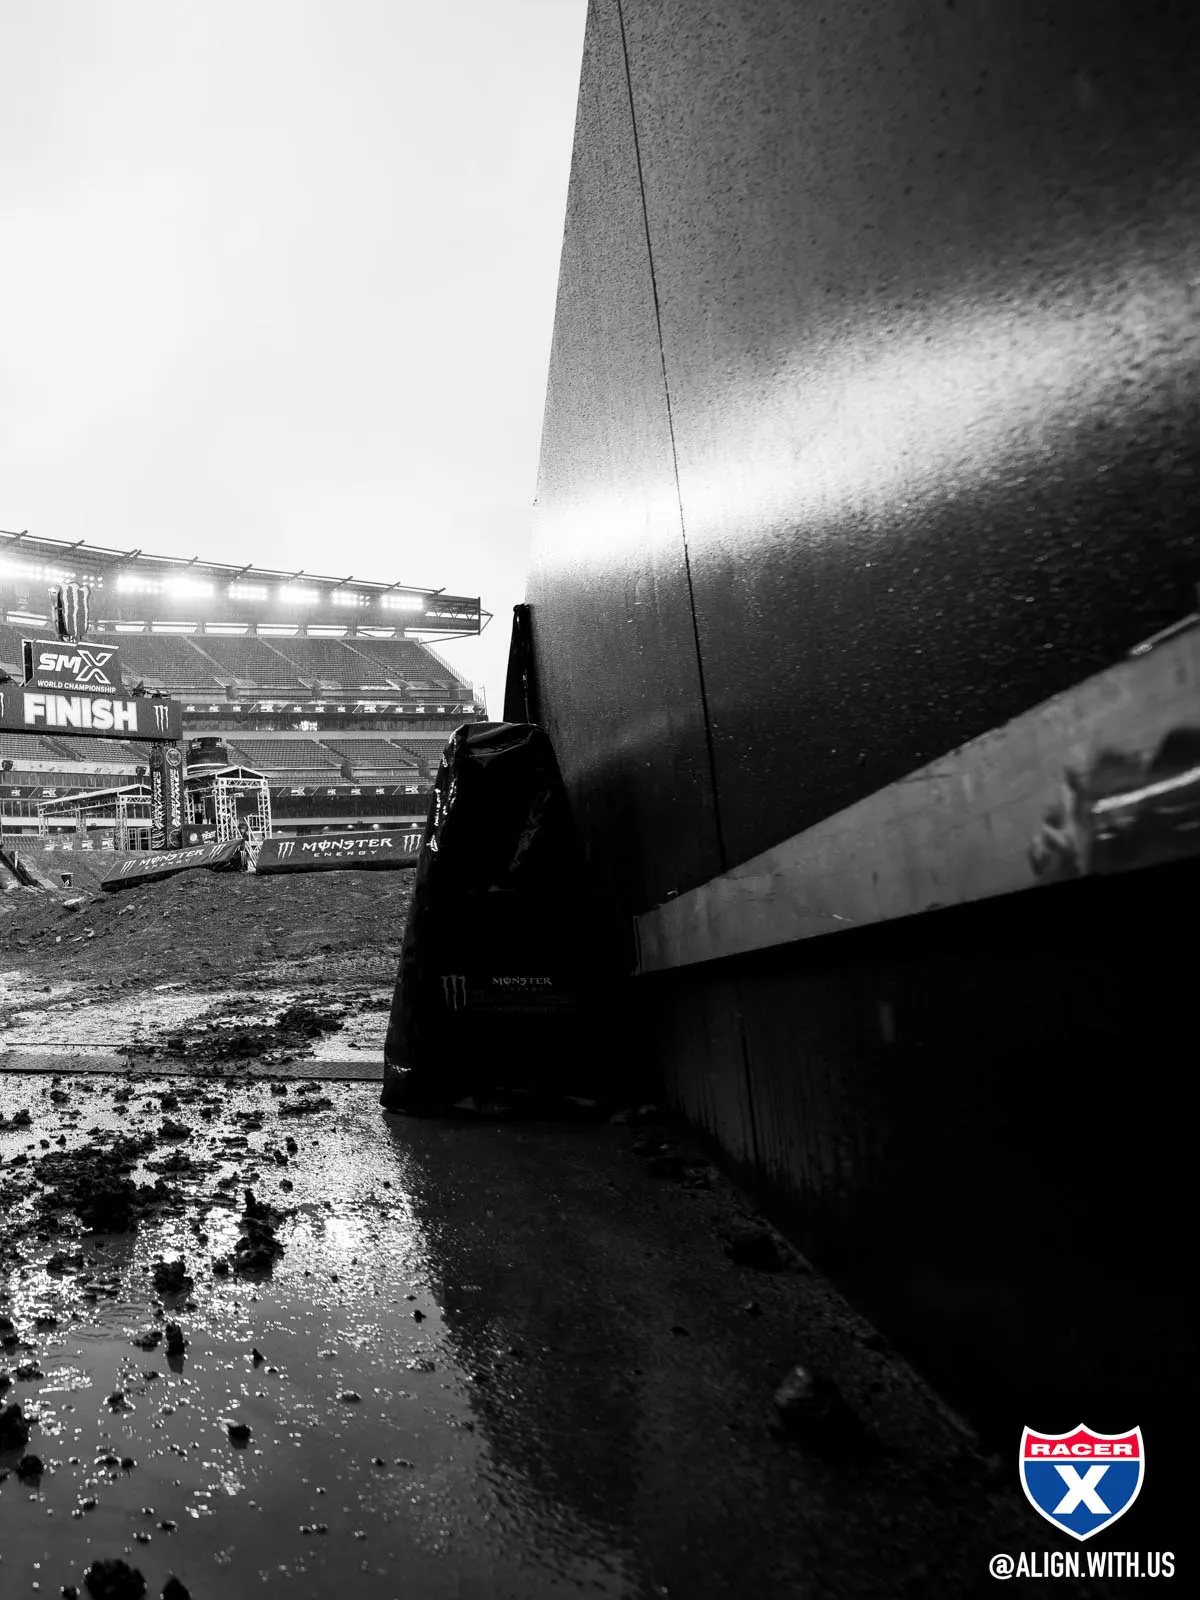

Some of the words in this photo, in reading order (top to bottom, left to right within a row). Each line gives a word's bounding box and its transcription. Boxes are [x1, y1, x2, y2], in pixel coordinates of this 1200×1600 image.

[37, 649, 113, 685] SMX
[37, 679, 63, 689] WORLD
[64, 682, 116, 694] CHAMPIONSHIP
[23, 692, 138, 732] FINISH
[302, 838, 393, 852] MONSTER
[139, 848, 205, 866] MONSTER
[313, 849, 377, 858] ENERGY
[492, 975, 553, 986] MONSTER
